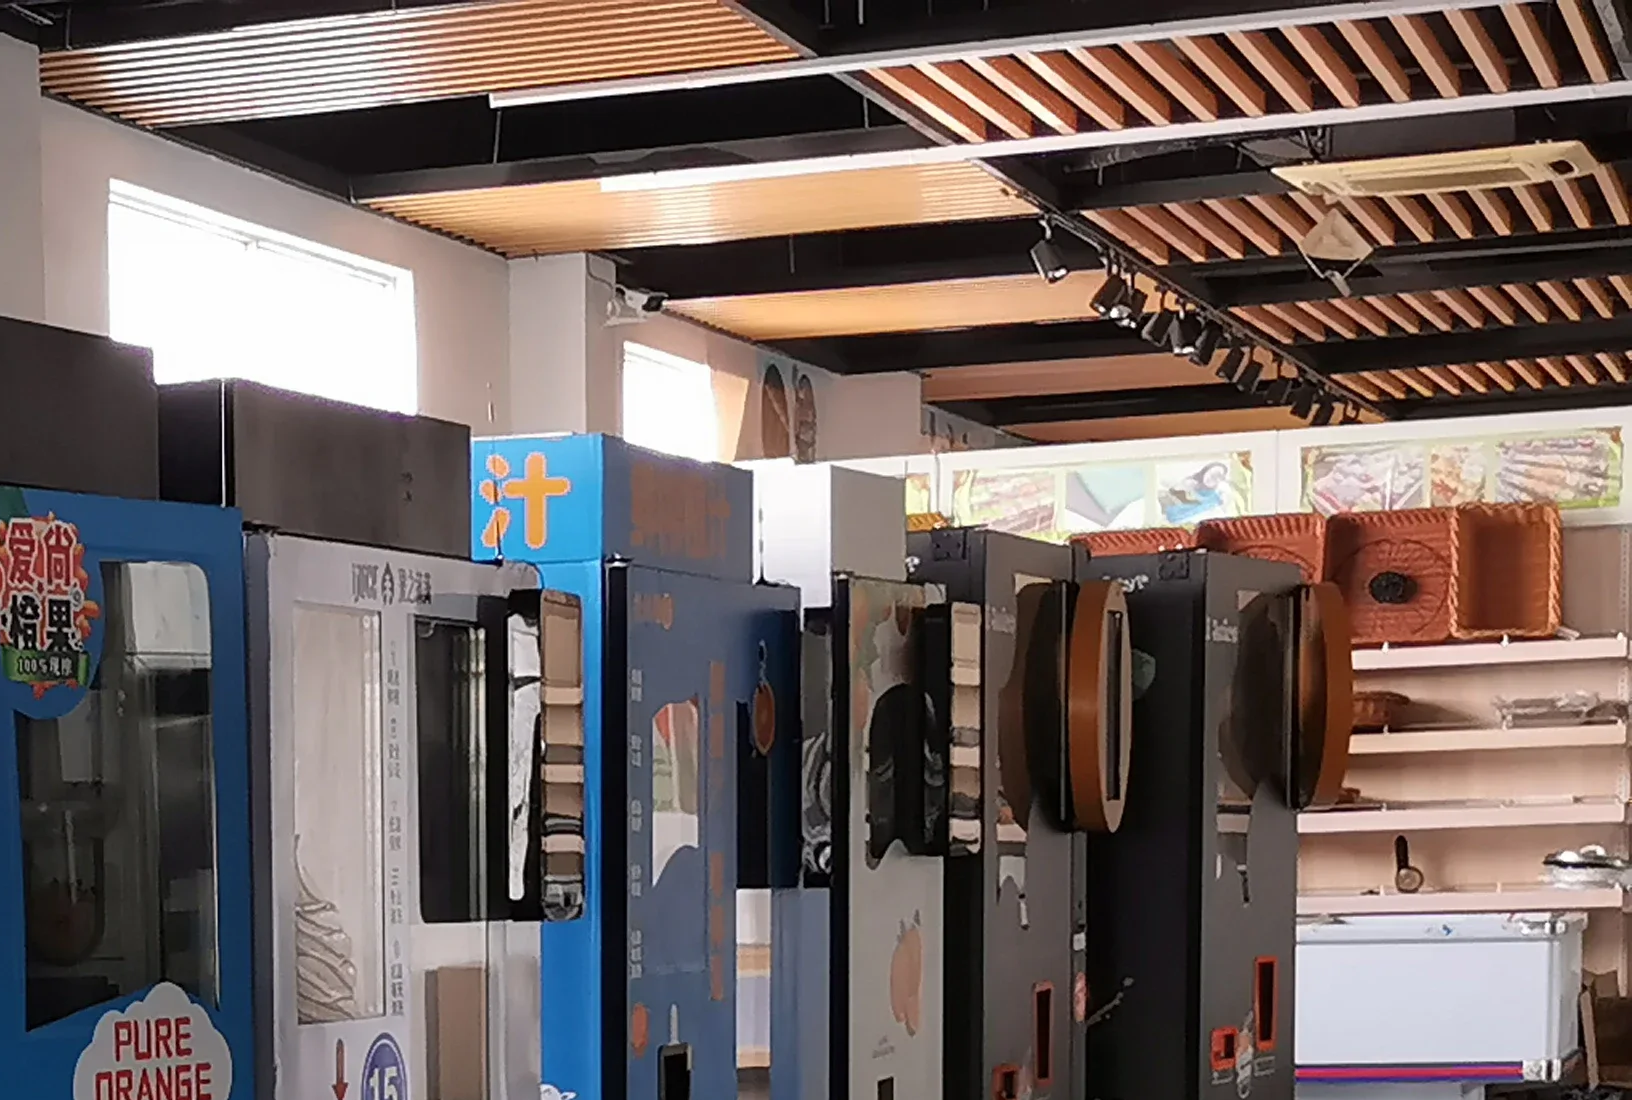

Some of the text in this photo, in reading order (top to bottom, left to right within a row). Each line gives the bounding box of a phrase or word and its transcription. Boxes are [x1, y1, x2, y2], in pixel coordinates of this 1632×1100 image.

[479, 451, 571, 550] 汁
[8, 521, 75, 588] 爱尚
[1, 594, 78, 651] 橙果
[114, 1016, 193, 1062] PURE
